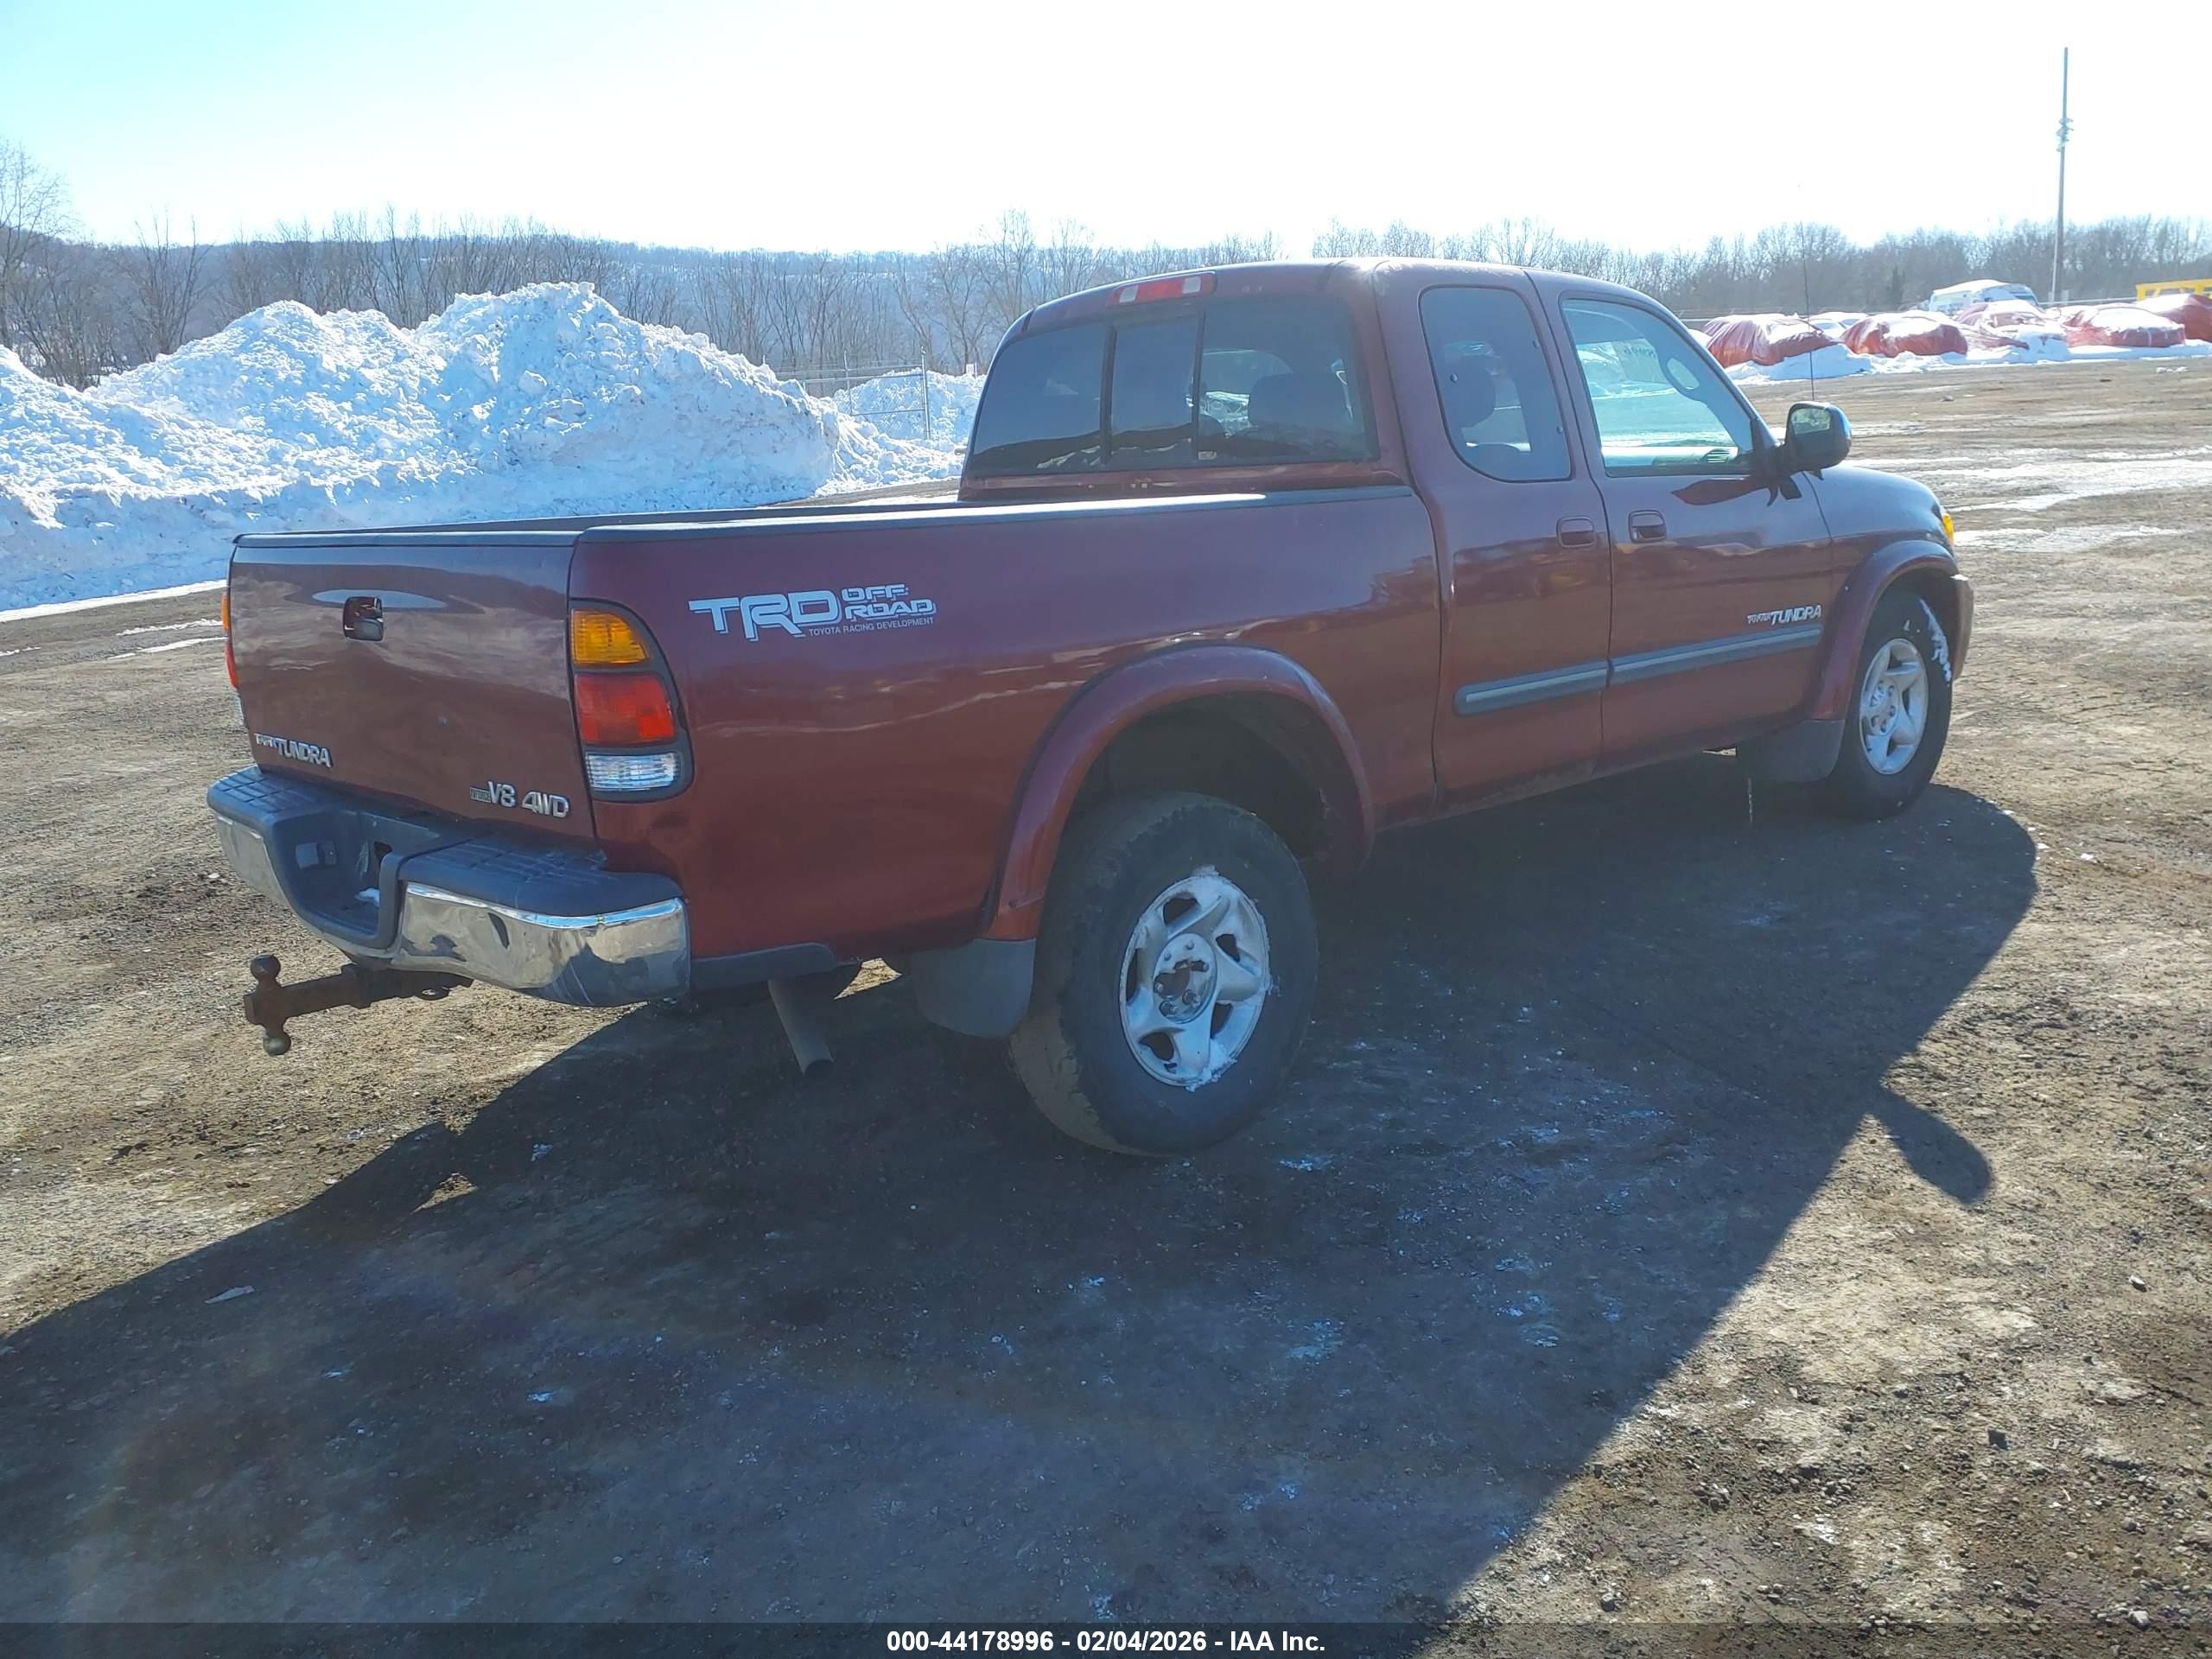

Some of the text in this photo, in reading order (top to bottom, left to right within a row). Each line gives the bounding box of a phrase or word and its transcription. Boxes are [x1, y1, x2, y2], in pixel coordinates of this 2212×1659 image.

[841, 584, 909, 603] OFF
[688, 590, 842, 641] TRD
[844, 599, 937, 622] ROAD
[1770, 605, 1822, 626] TUNDRA
[809, 617, 935, 637] TOYOTA RACING DEVELOPMENT
[276, 737, 332, 768] TUNDRA
[487, 780, 517, 808] V8
[521, 791, 570, 818] 4WD
